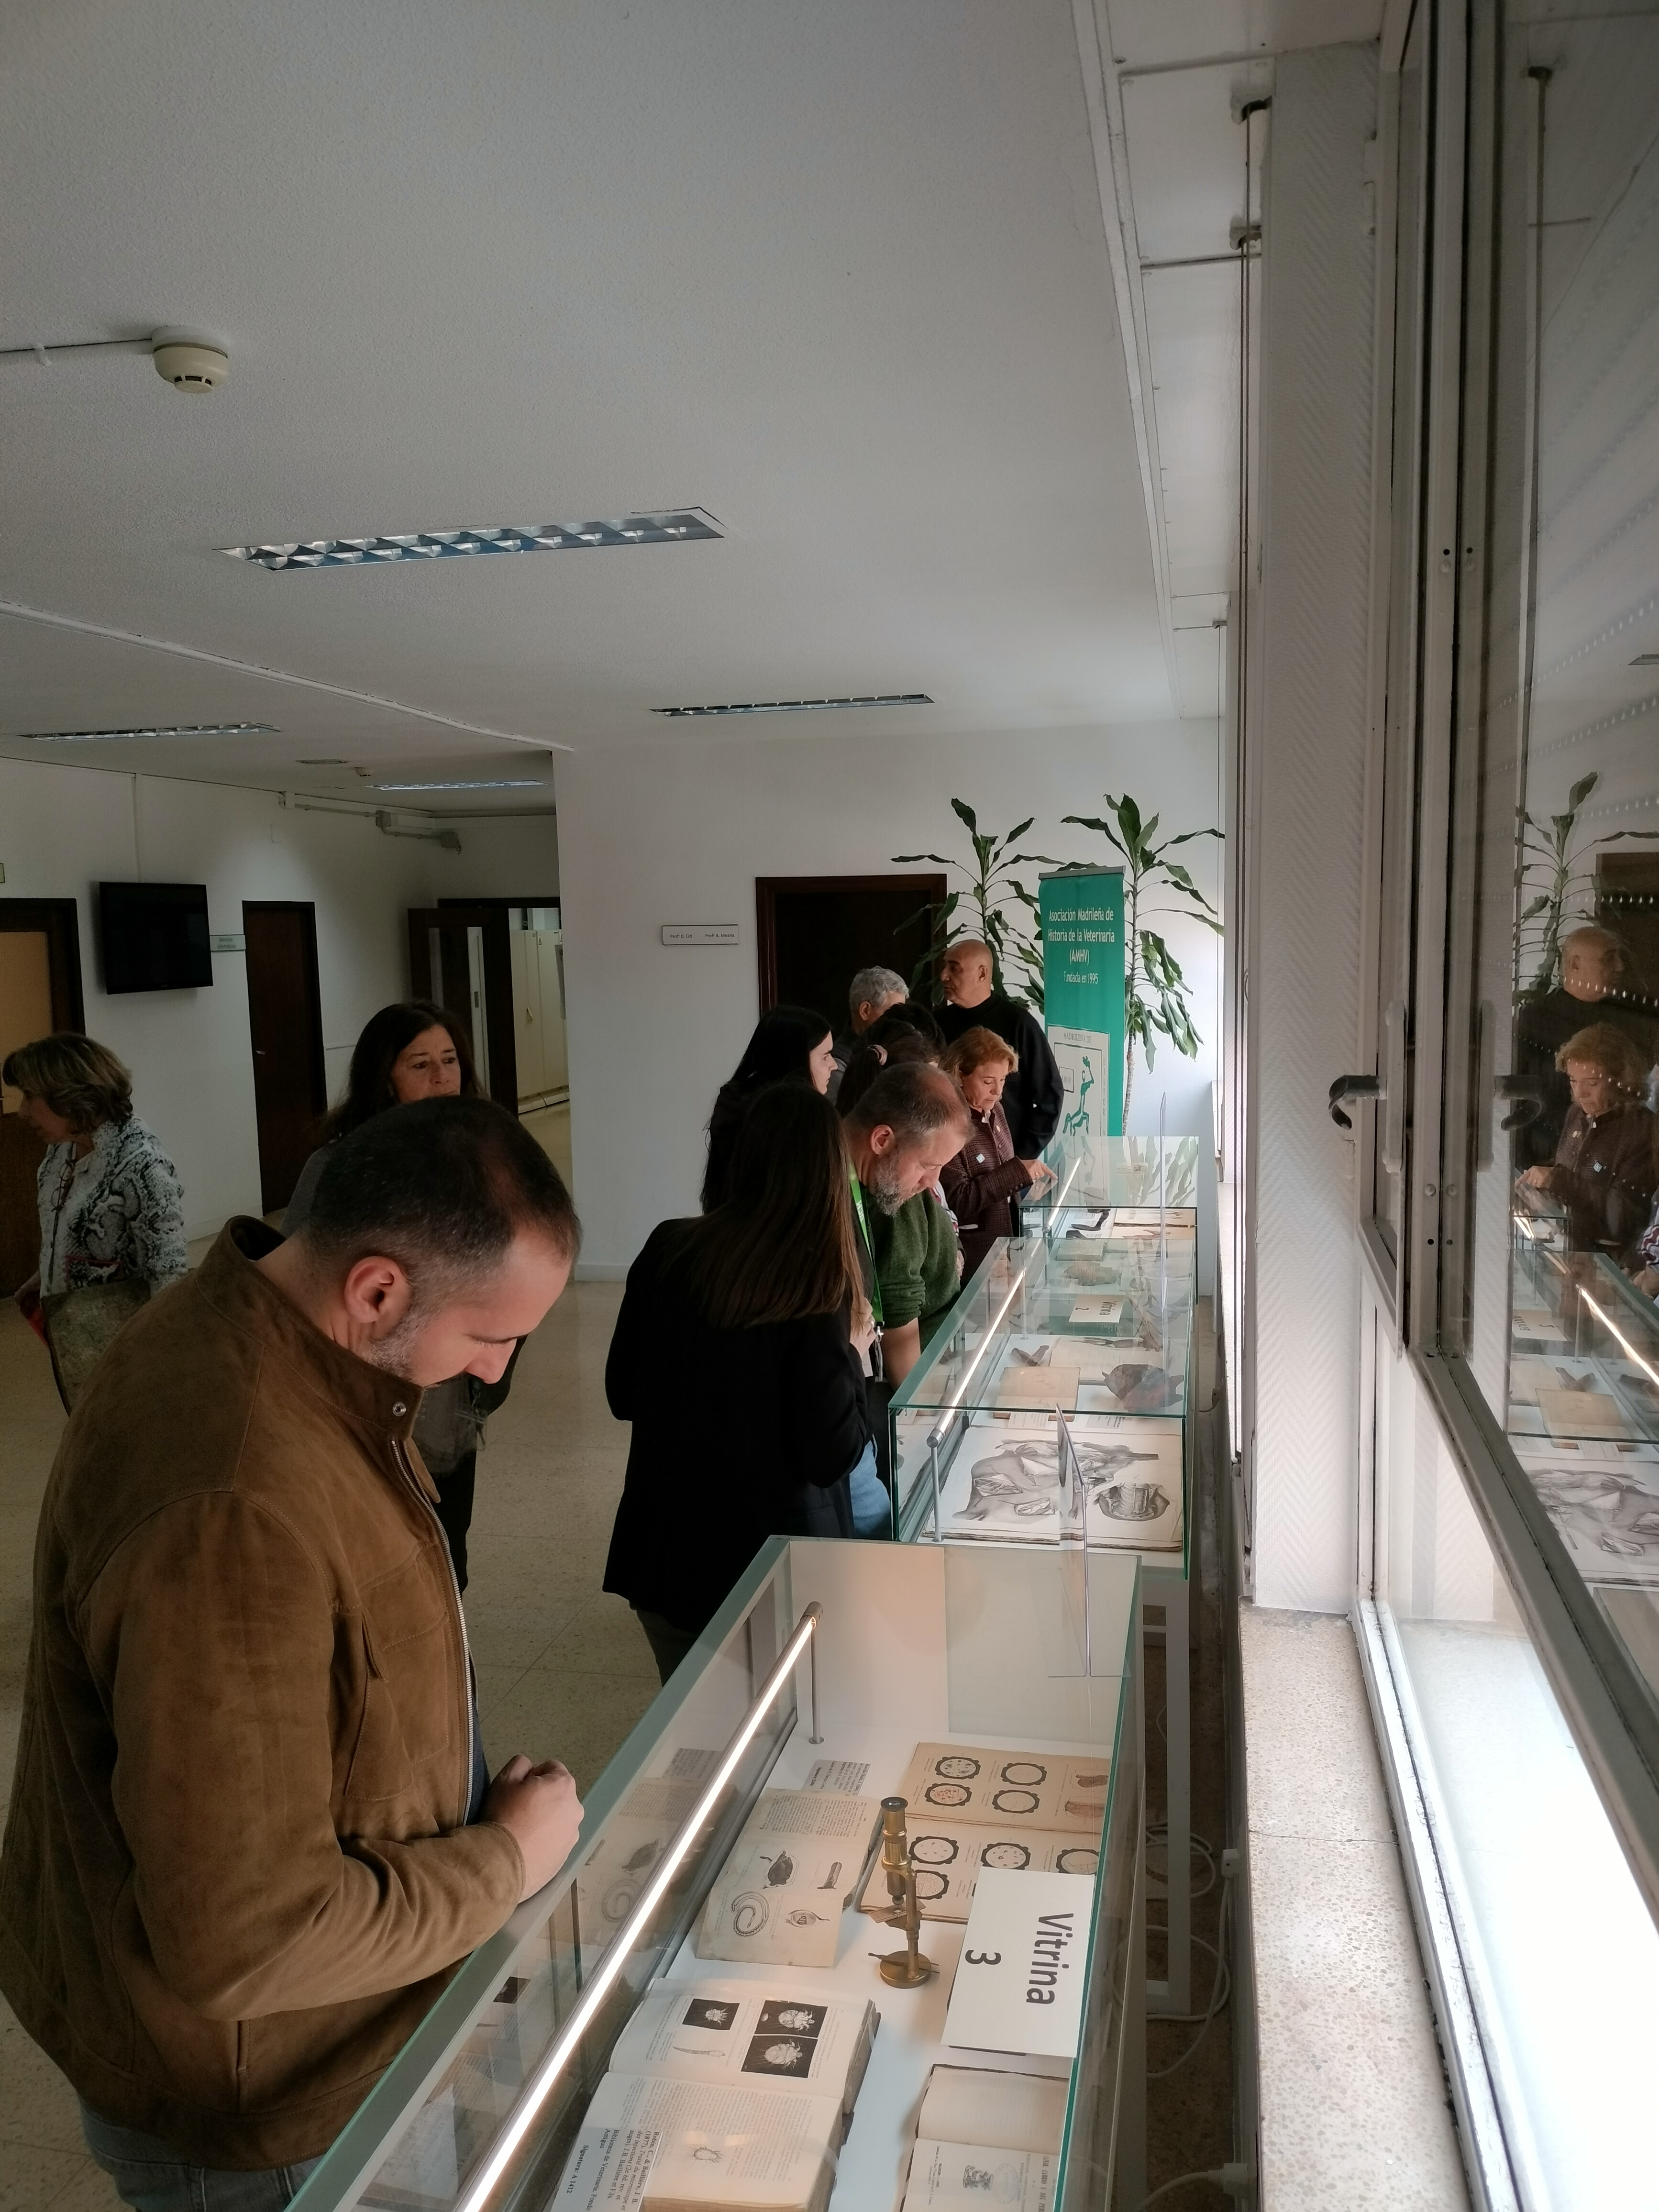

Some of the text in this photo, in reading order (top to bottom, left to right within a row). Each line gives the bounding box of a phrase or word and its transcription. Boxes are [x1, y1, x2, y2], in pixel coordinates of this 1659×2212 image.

[1049, 907, 1114, 921] Asociación Madrileña de
[1048, 928, 1115, 942] Historia de la Veterinaria
[1069, 949, 1090, 966] (AMHV)
[1063, 971, 1099, 984] Fundada en 1995
[1063, 1032, 1086, 1042] MADRILEÑA
[1099, 1301, 1117, 1316] Vitrina
[965, 1949, 1002, 1965] 3
[1026, 1913, 1074, 2004] Vitrina
[599, 2129, 611, 2149] Antiguo
[607, 2129, 620, 2154] Biblioteca
[650, 2132, 660, 2149] Robin,
[574, 2145, 589, 2173] Signatura:
[628, 2140, 640, 2165] injections
[638, 2150, 646, 2166] Traité
[592, 2163, 608, 2192] Veterinaria.
[613, 2159, 626, 2181] Baillière
[635, 2166, 649, 2190] Baillière,
[566, 2180, 576, 2194] 1412
[607, 2188, 616, 2200] Fils.
[623, 2174, 636, 2204] microscope
[586, 2194, 597, 2211] Fondo
